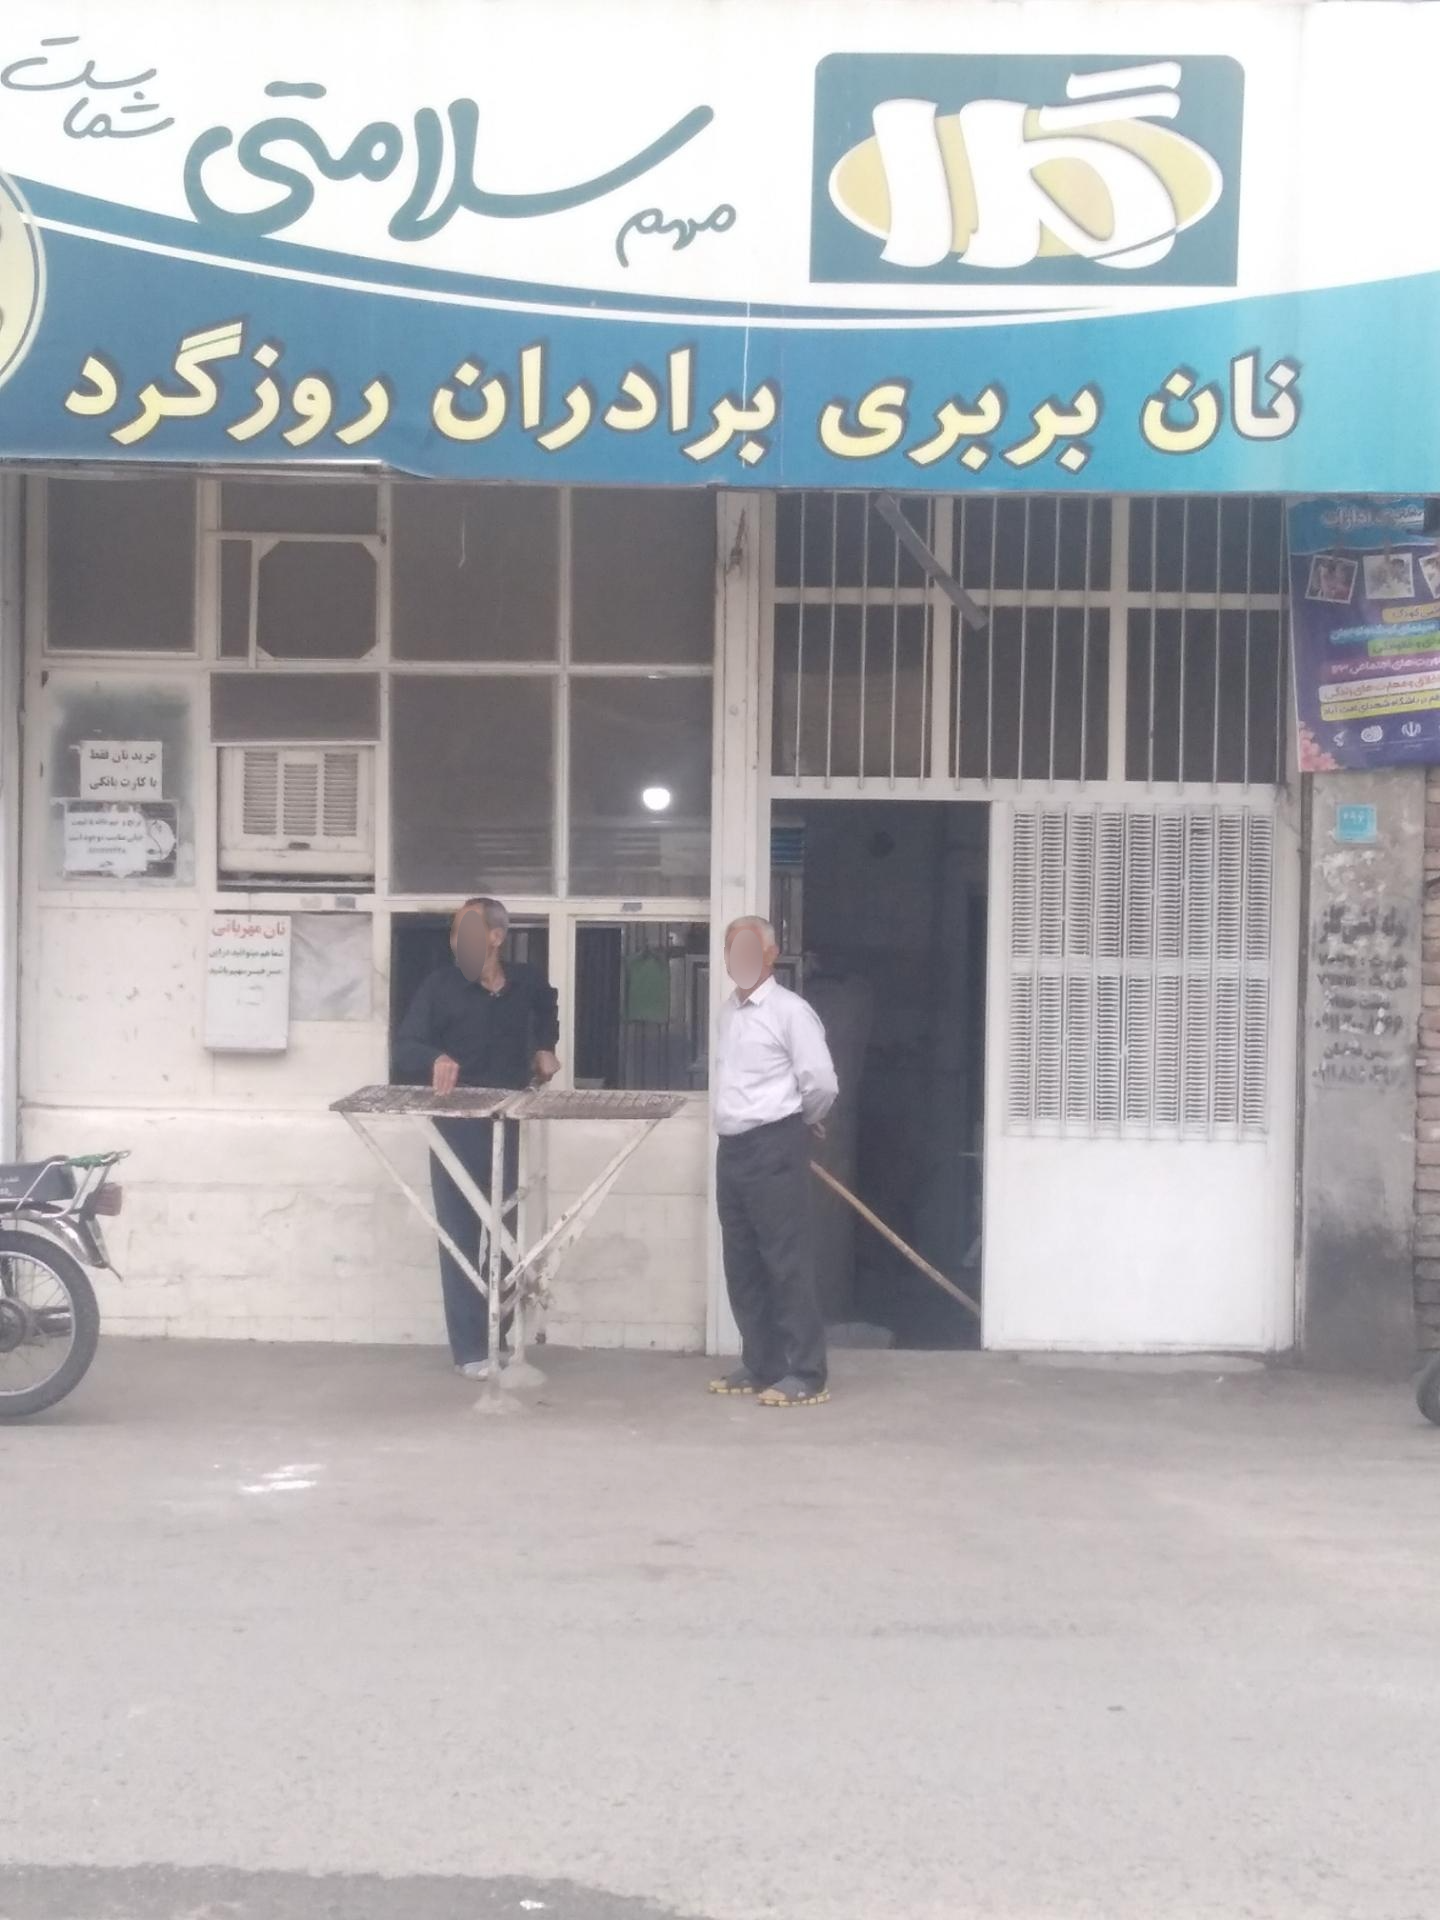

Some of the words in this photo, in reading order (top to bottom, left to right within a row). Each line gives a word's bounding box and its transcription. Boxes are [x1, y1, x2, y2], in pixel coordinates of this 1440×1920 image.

[183, 81, 714, 242] سلامتی
[63, 321, 391, 447] روزگرد
[431, 344, 777, 466] برادران
[1142, 354, 1298, 454] نان
[818, 383, 1099, 473] بربری
[112, 750, 129, 764] نان
[89, 776, 118, 791] بانکی
[120, 776, 146, 792] کارت
[149, 776, 158, 788] با
[211, 918, 262, 939] مهربانی
[263, 920, 286, 940] نان
